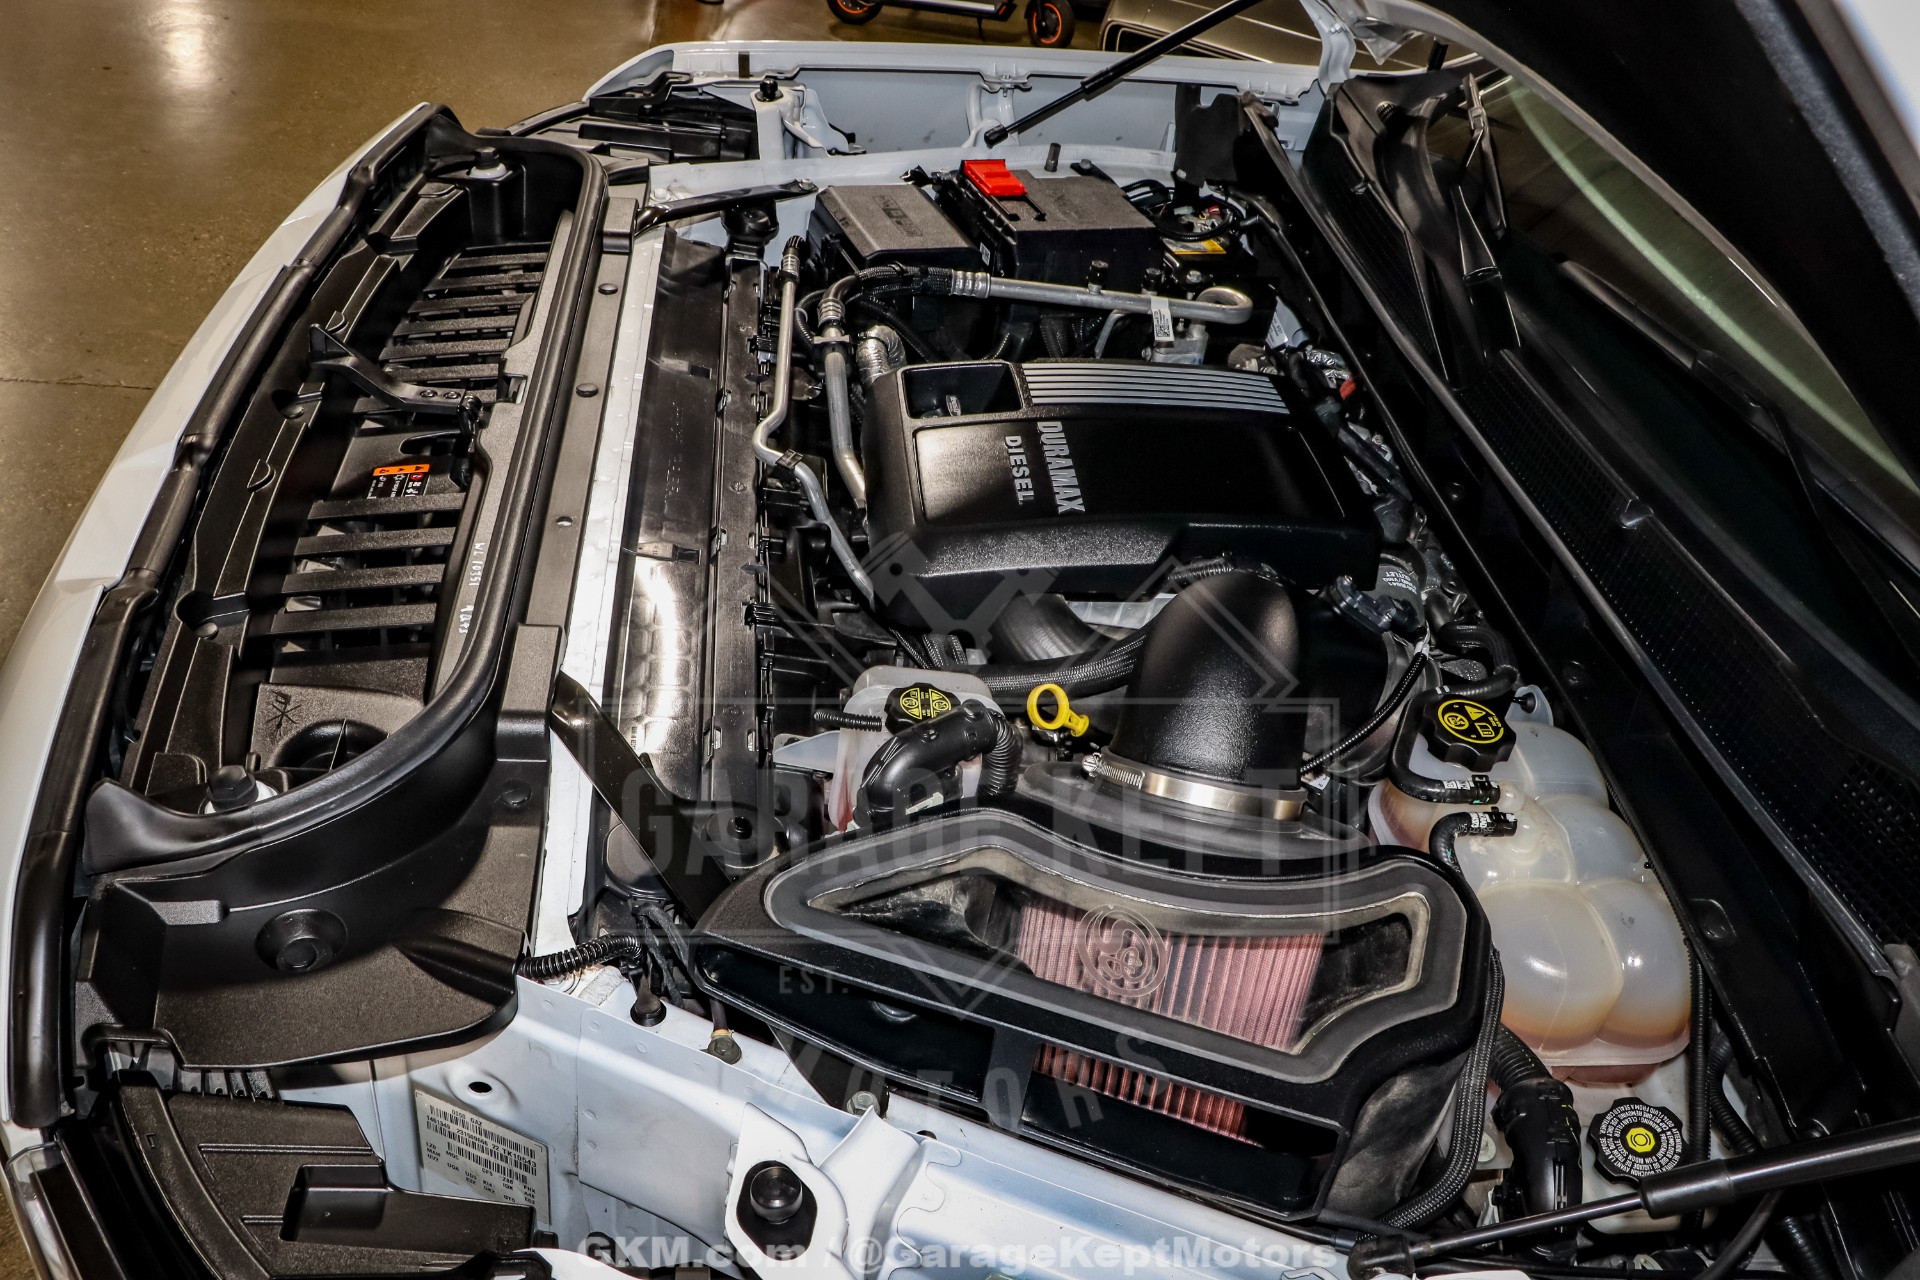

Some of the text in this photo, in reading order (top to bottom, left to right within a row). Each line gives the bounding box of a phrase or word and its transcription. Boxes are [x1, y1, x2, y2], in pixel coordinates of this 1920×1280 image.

[1004, 435, 1034, 505] DIESEL
[1037, 421, 1085, 514] DURAMAX
[492, 1143, 500, 1151] 22
